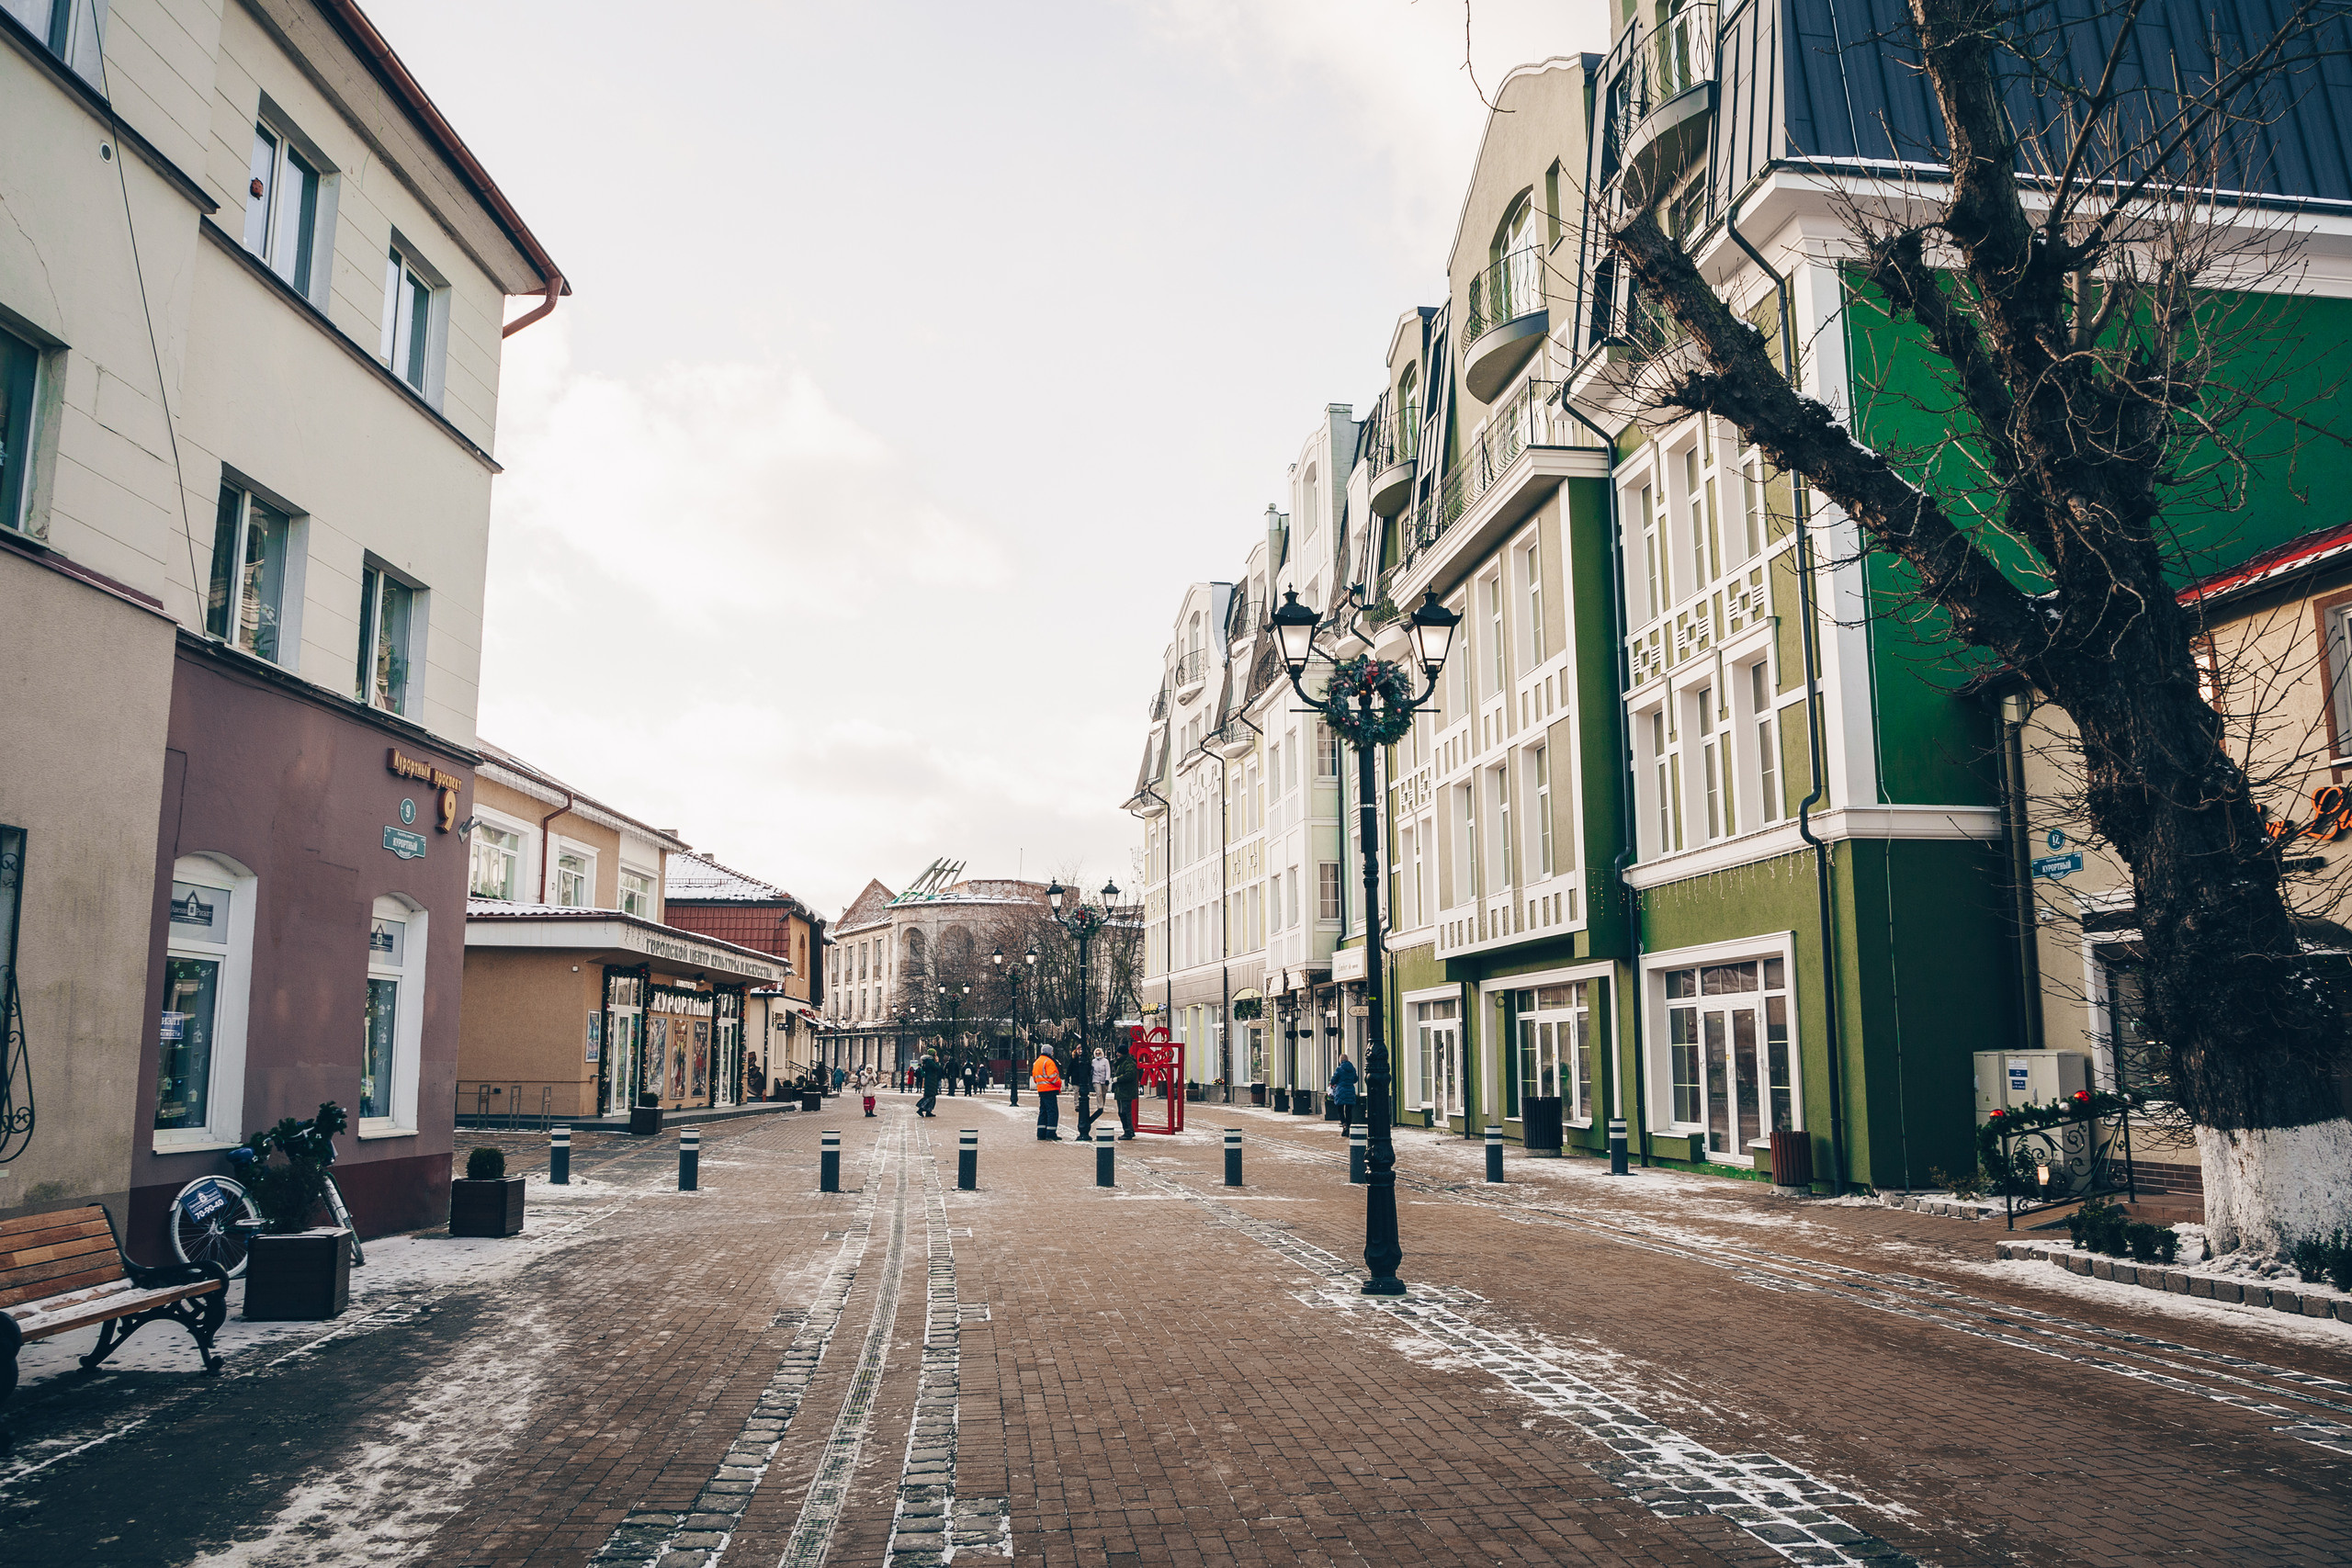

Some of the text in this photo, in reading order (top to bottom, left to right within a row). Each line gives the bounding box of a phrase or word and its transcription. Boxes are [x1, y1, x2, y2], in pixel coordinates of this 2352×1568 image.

[393, 749, 462, 792] Курортный проспект
[405, 805, 411, 818] 9
[444, 790, 457, 831] 9
[392, 837, 418, 852] КУРОРТНЫЙ
[2042, 860, 2072, 873] КУРОРТНЫЙ
[646, 938, 773, 979] ГОРОДСКОЙ ЦЕНТР КУЛЬТУРЫ И ИСКУССТВА
[653, 991, 713, 1017] КУРОРТНЫЙ
[194, 1199, 224, 1220] 70-90-40
